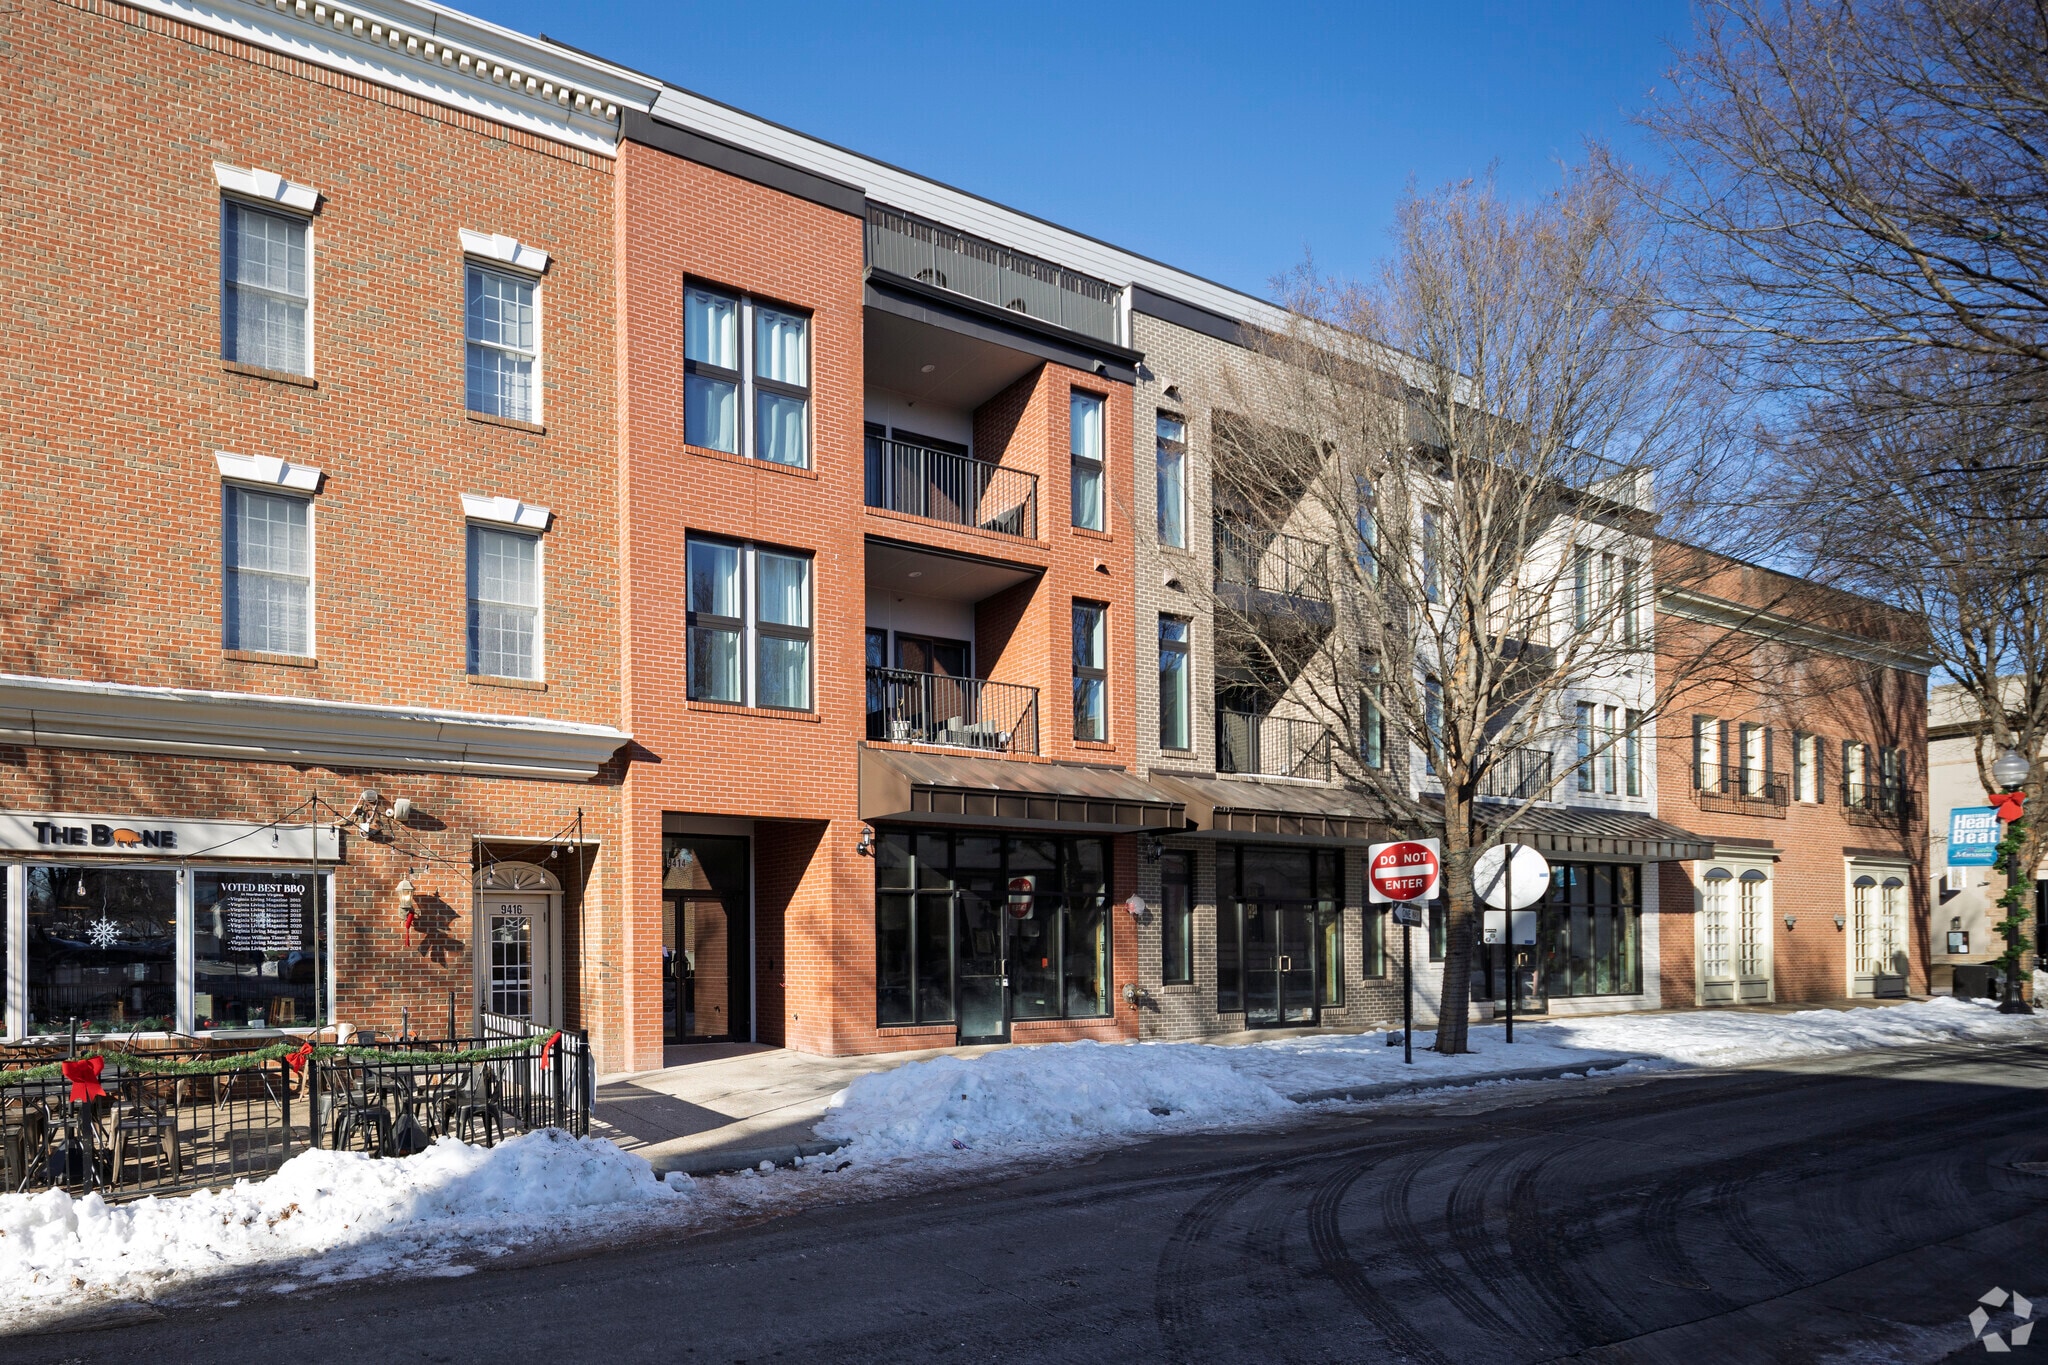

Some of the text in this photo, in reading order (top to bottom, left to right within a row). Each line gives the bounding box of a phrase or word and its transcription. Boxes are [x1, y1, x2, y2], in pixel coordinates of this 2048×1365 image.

[1954, 814, 1998, 829] Heart
[32, 822, 173, 848] THE BNE
[1952, 830, 1998, 844] Beat
[667, 858, 686, 868] 9414
[1380, 852, 1428, 865] DO NOT
[221, 882, 305, 895] VOTED BEST BBQ
[1386, 878, 1422, 890] ENTER
[500, 904, 522, 914] 9416
